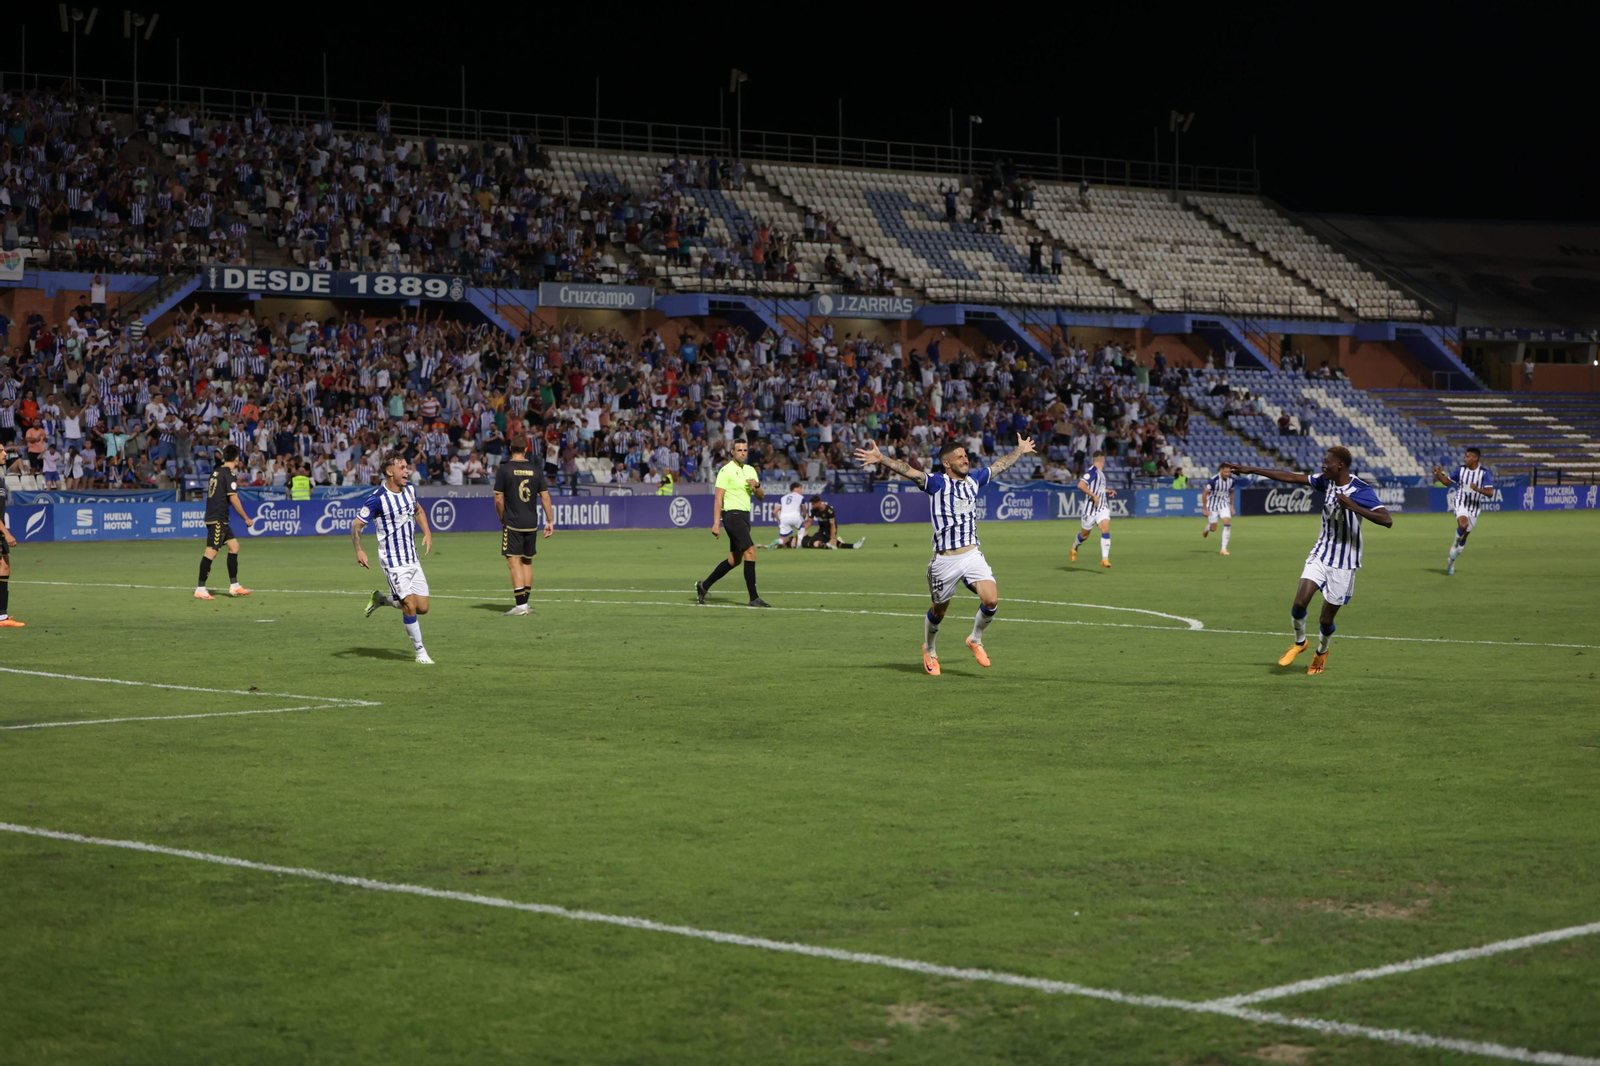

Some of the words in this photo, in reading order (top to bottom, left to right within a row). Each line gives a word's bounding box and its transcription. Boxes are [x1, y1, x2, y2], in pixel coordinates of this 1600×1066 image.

[224, 269, 330, 293] DESDE
[350, 274, 448, 298] 1889
[560, 286, 635, 307] Cruzcampo
[837, 296, 913, 313] J.ZARRIAS
[519, 479, 531, 502] 6
[1544, 485, 1574, 496] TAPICERÍA
[786, 496, 793, 505] 6
[1002, 493, 1033, 507] Eternal
[1544, 496, 1578, 504] RAIMUNDO
[257, 502, 300, 519] Eternal
[324, 501, 361, 519] Eterna
[997, 506, 1033, 520] Energy
[182, 520, 206, 528] MOTO
[248, 517, 301, 535] Energy
[315, 517, 354, 534] Ener
[392, 572, 400, 585] 2
